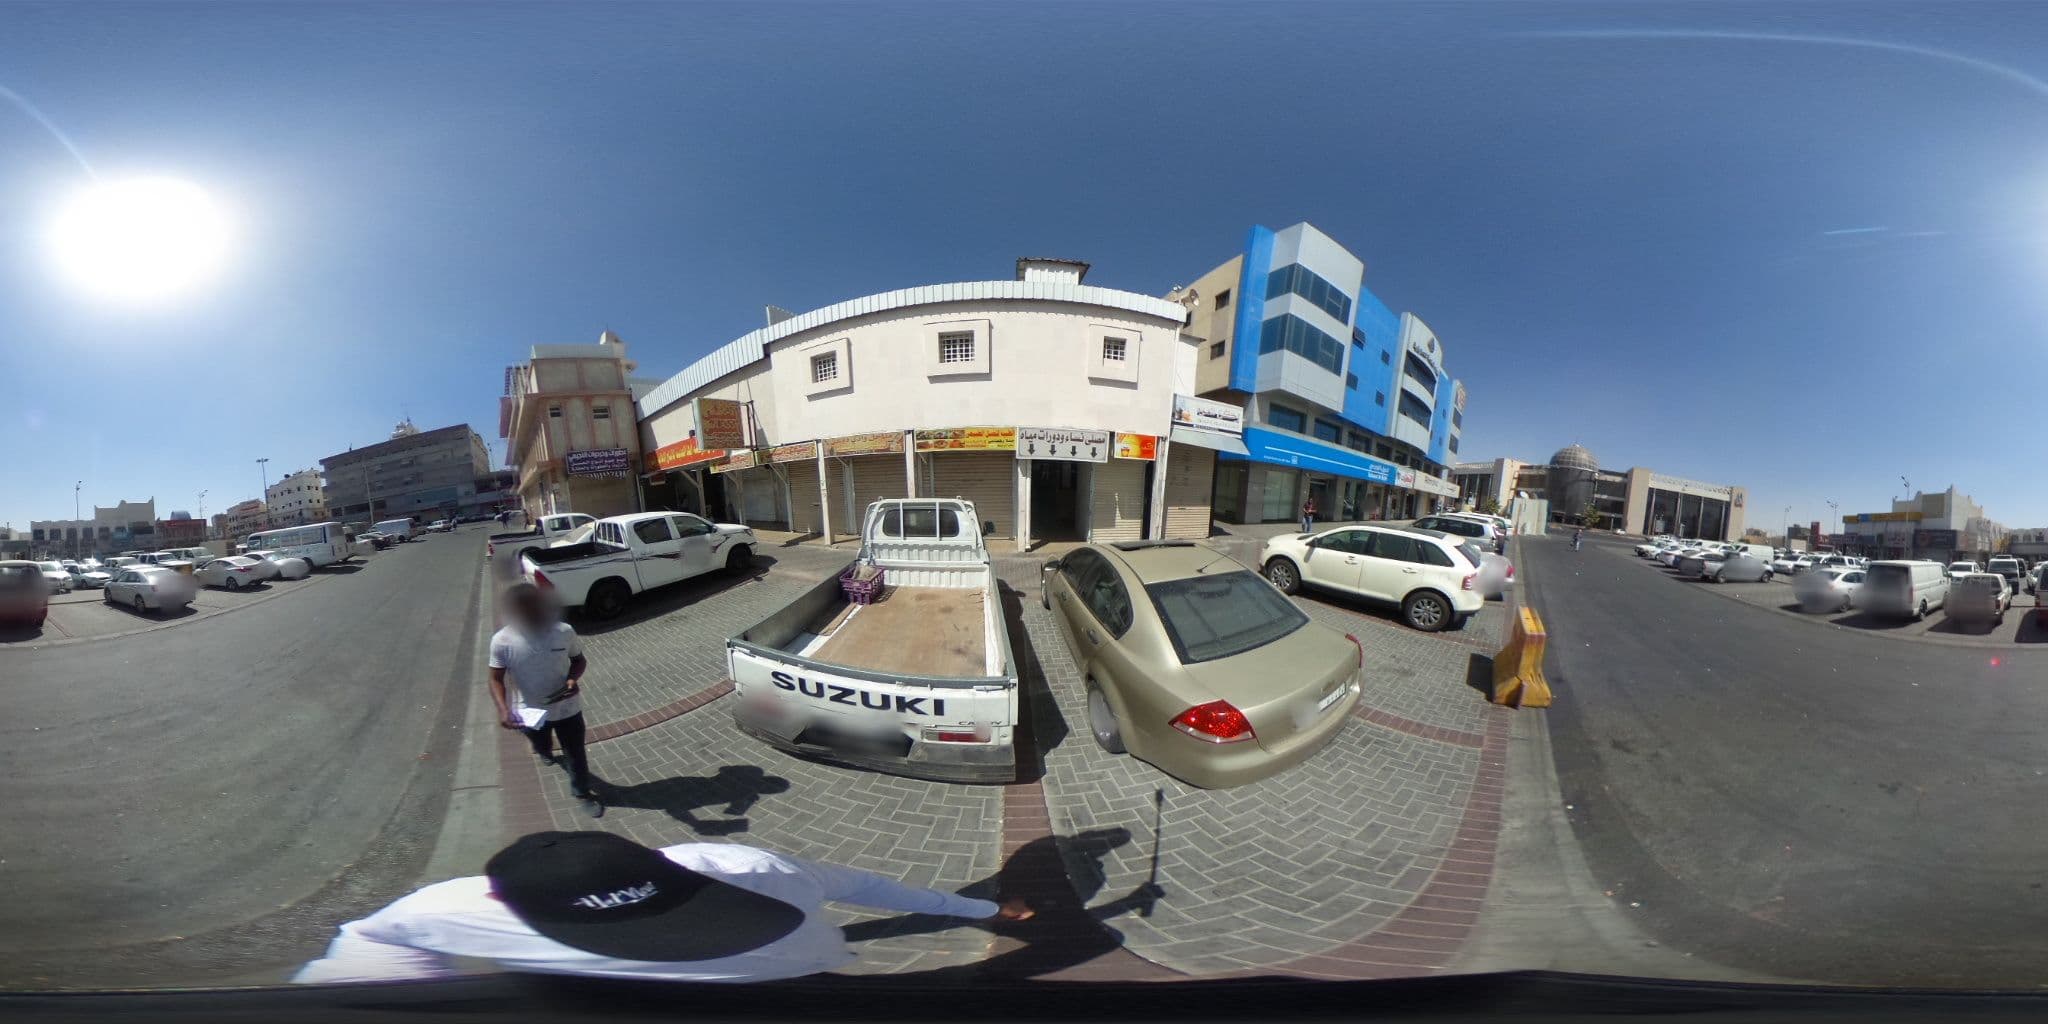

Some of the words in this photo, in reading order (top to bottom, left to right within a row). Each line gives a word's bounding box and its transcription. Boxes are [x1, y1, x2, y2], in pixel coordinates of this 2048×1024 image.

[1020, 430, 1037, 442] مياه
[1039, 430, 1065, 444] ودورات
[1065, 431, 1084, 444] نساء
[1084, 432, 1106, 445] مصلى
[771, 670, 945, 717] SUZUKI
